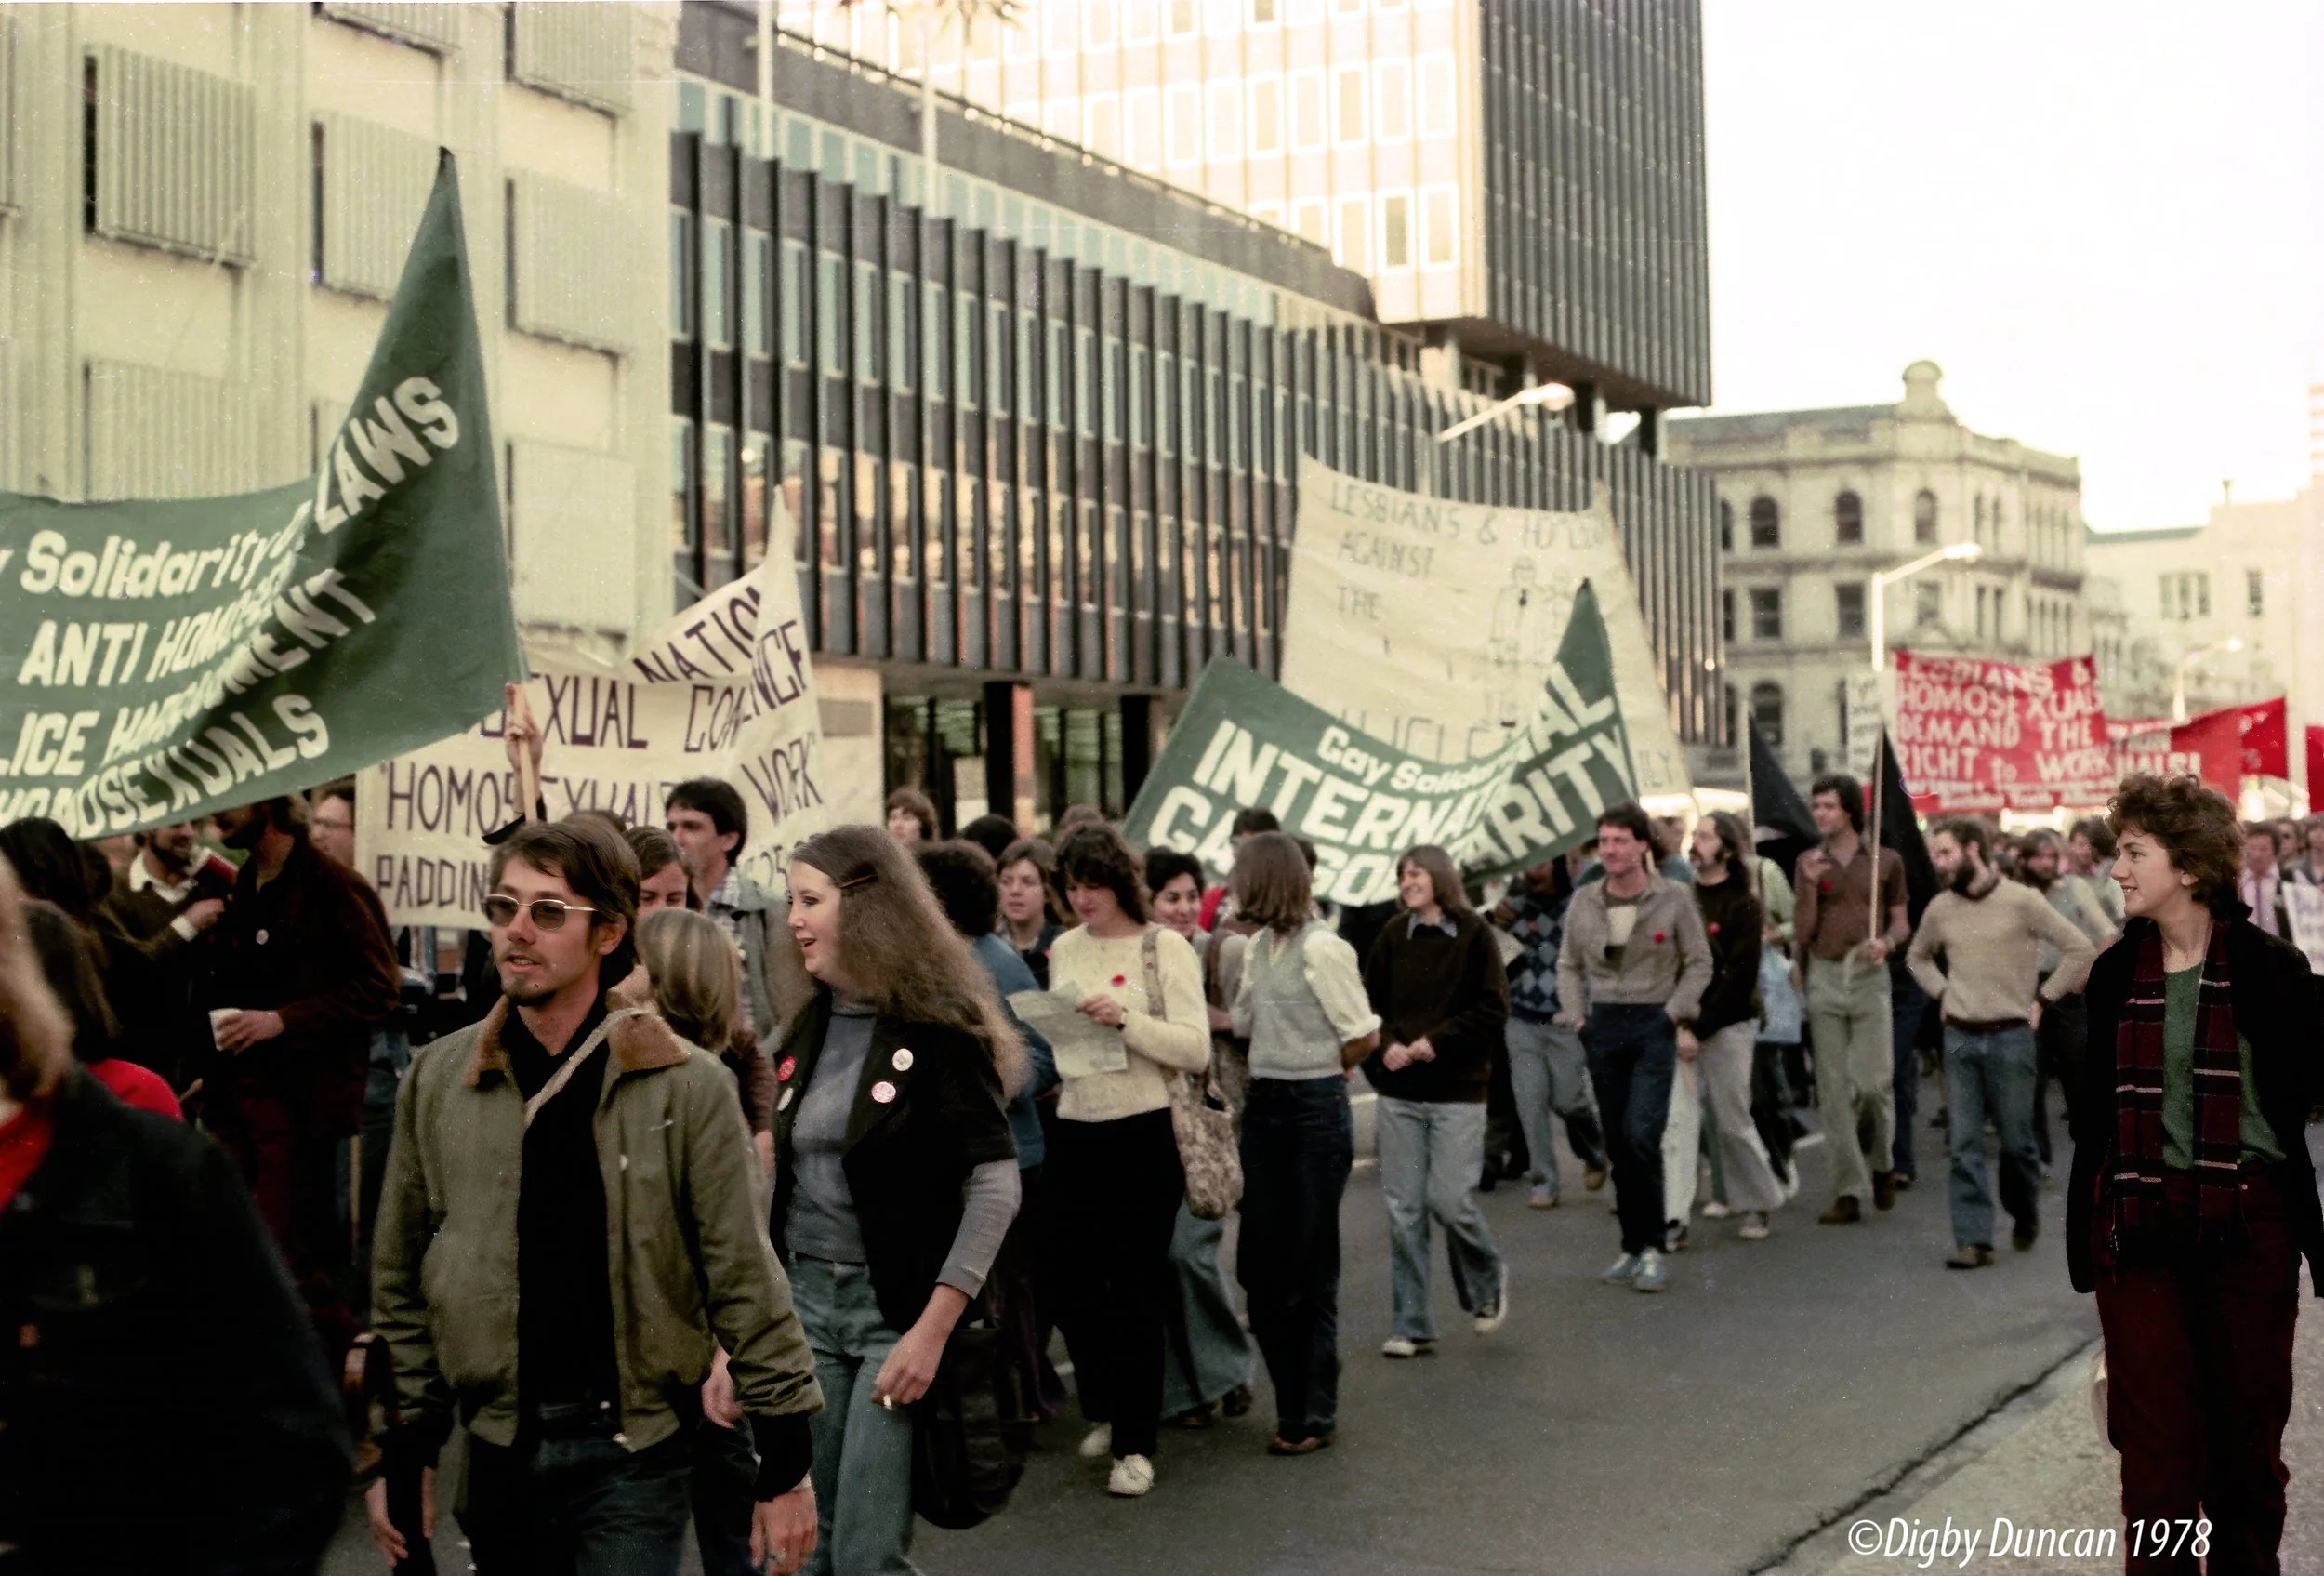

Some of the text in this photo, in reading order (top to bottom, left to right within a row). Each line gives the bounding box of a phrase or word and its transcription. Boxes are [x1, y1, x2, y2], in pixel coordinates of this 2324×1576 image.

[18, 620, 149, 686] ANTI
[314, 376, 459, 534] LAWS
[1330, 480, 1460, 539] LESBIANS
[1476, 512, 1498, 546] &
[20, 529, 271, 597] Solidarity
[1339, 527, 1434, 580] AGAINST
[1336, 583, 1380, 621] THE
[1317, 725, 1392, 787] Gay
[2034, 746, 2114, 783] WORK
[2039, 720, 2093, 752] THE
[1149, 785, 1237, 876] GA
[376, 853, 494, 912] PADDIN
